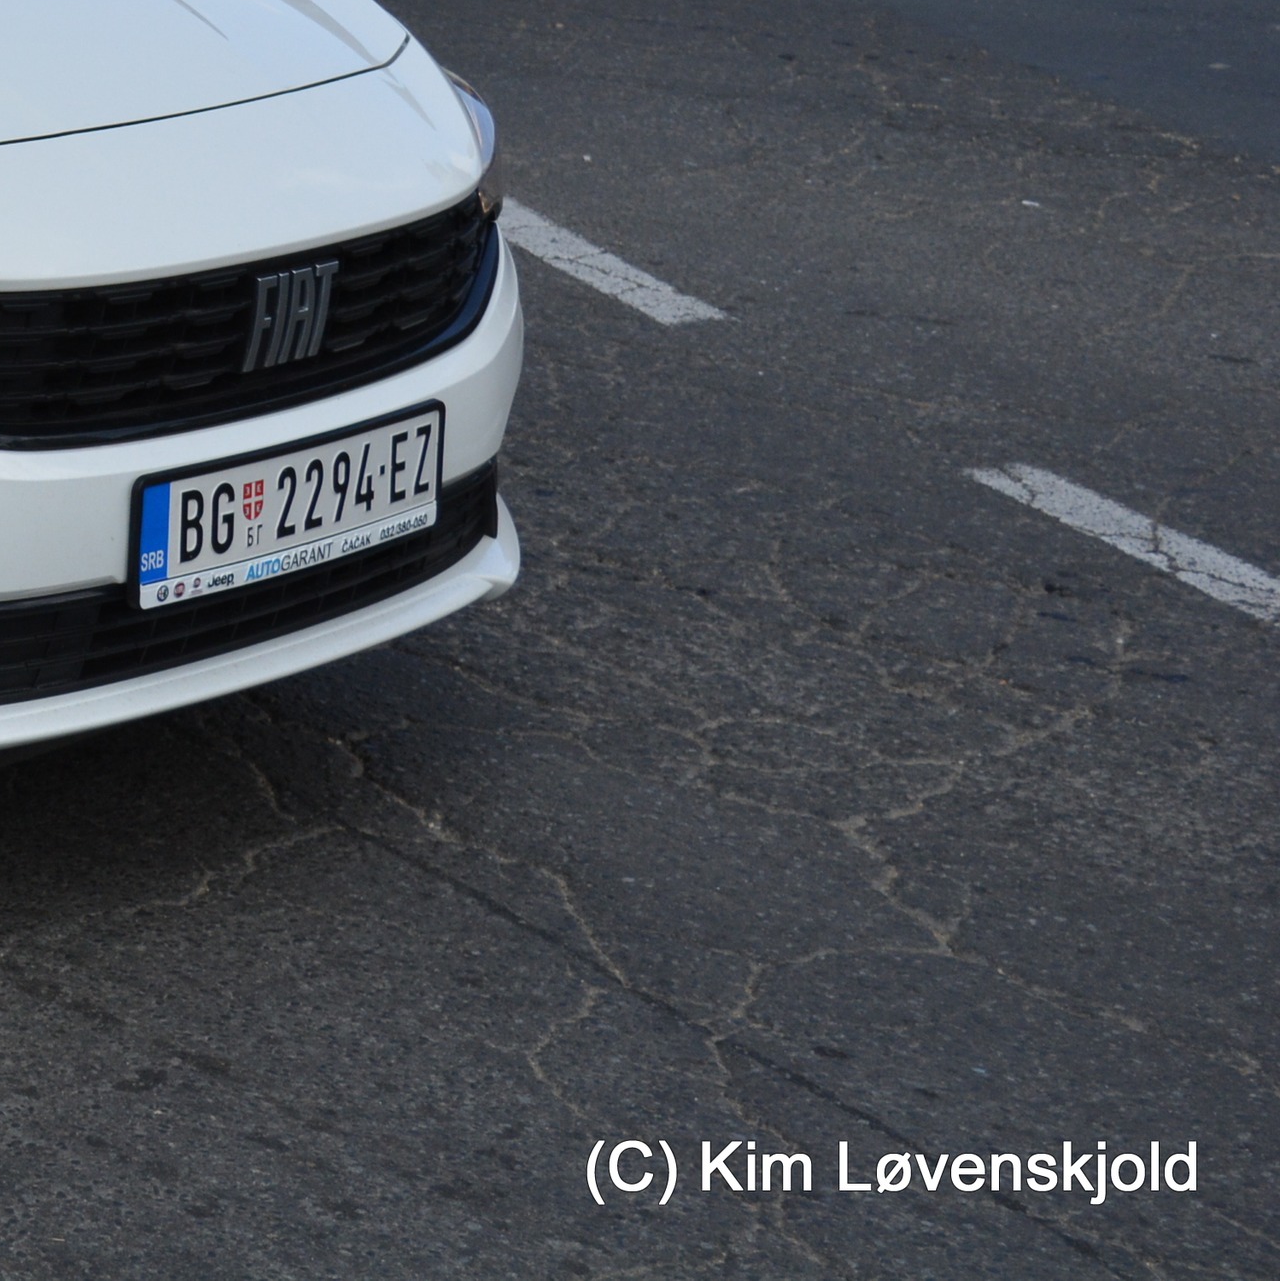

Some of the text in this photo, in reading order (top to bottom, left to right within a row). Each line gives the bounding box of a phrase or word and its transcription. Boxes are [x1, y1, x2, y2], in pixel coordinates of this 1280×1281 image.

[242, 260, 339, 373] FIAT
[179, 482, 236, 564] BG
[246, 524, 264, 548] БГ
[141, 549, 164, 571] SRB
[207, 572, 234, 588] Jeep
[245, 542, 333, 581] AUTOGARANT
[341, 532, 371, 554] ČAČAK
